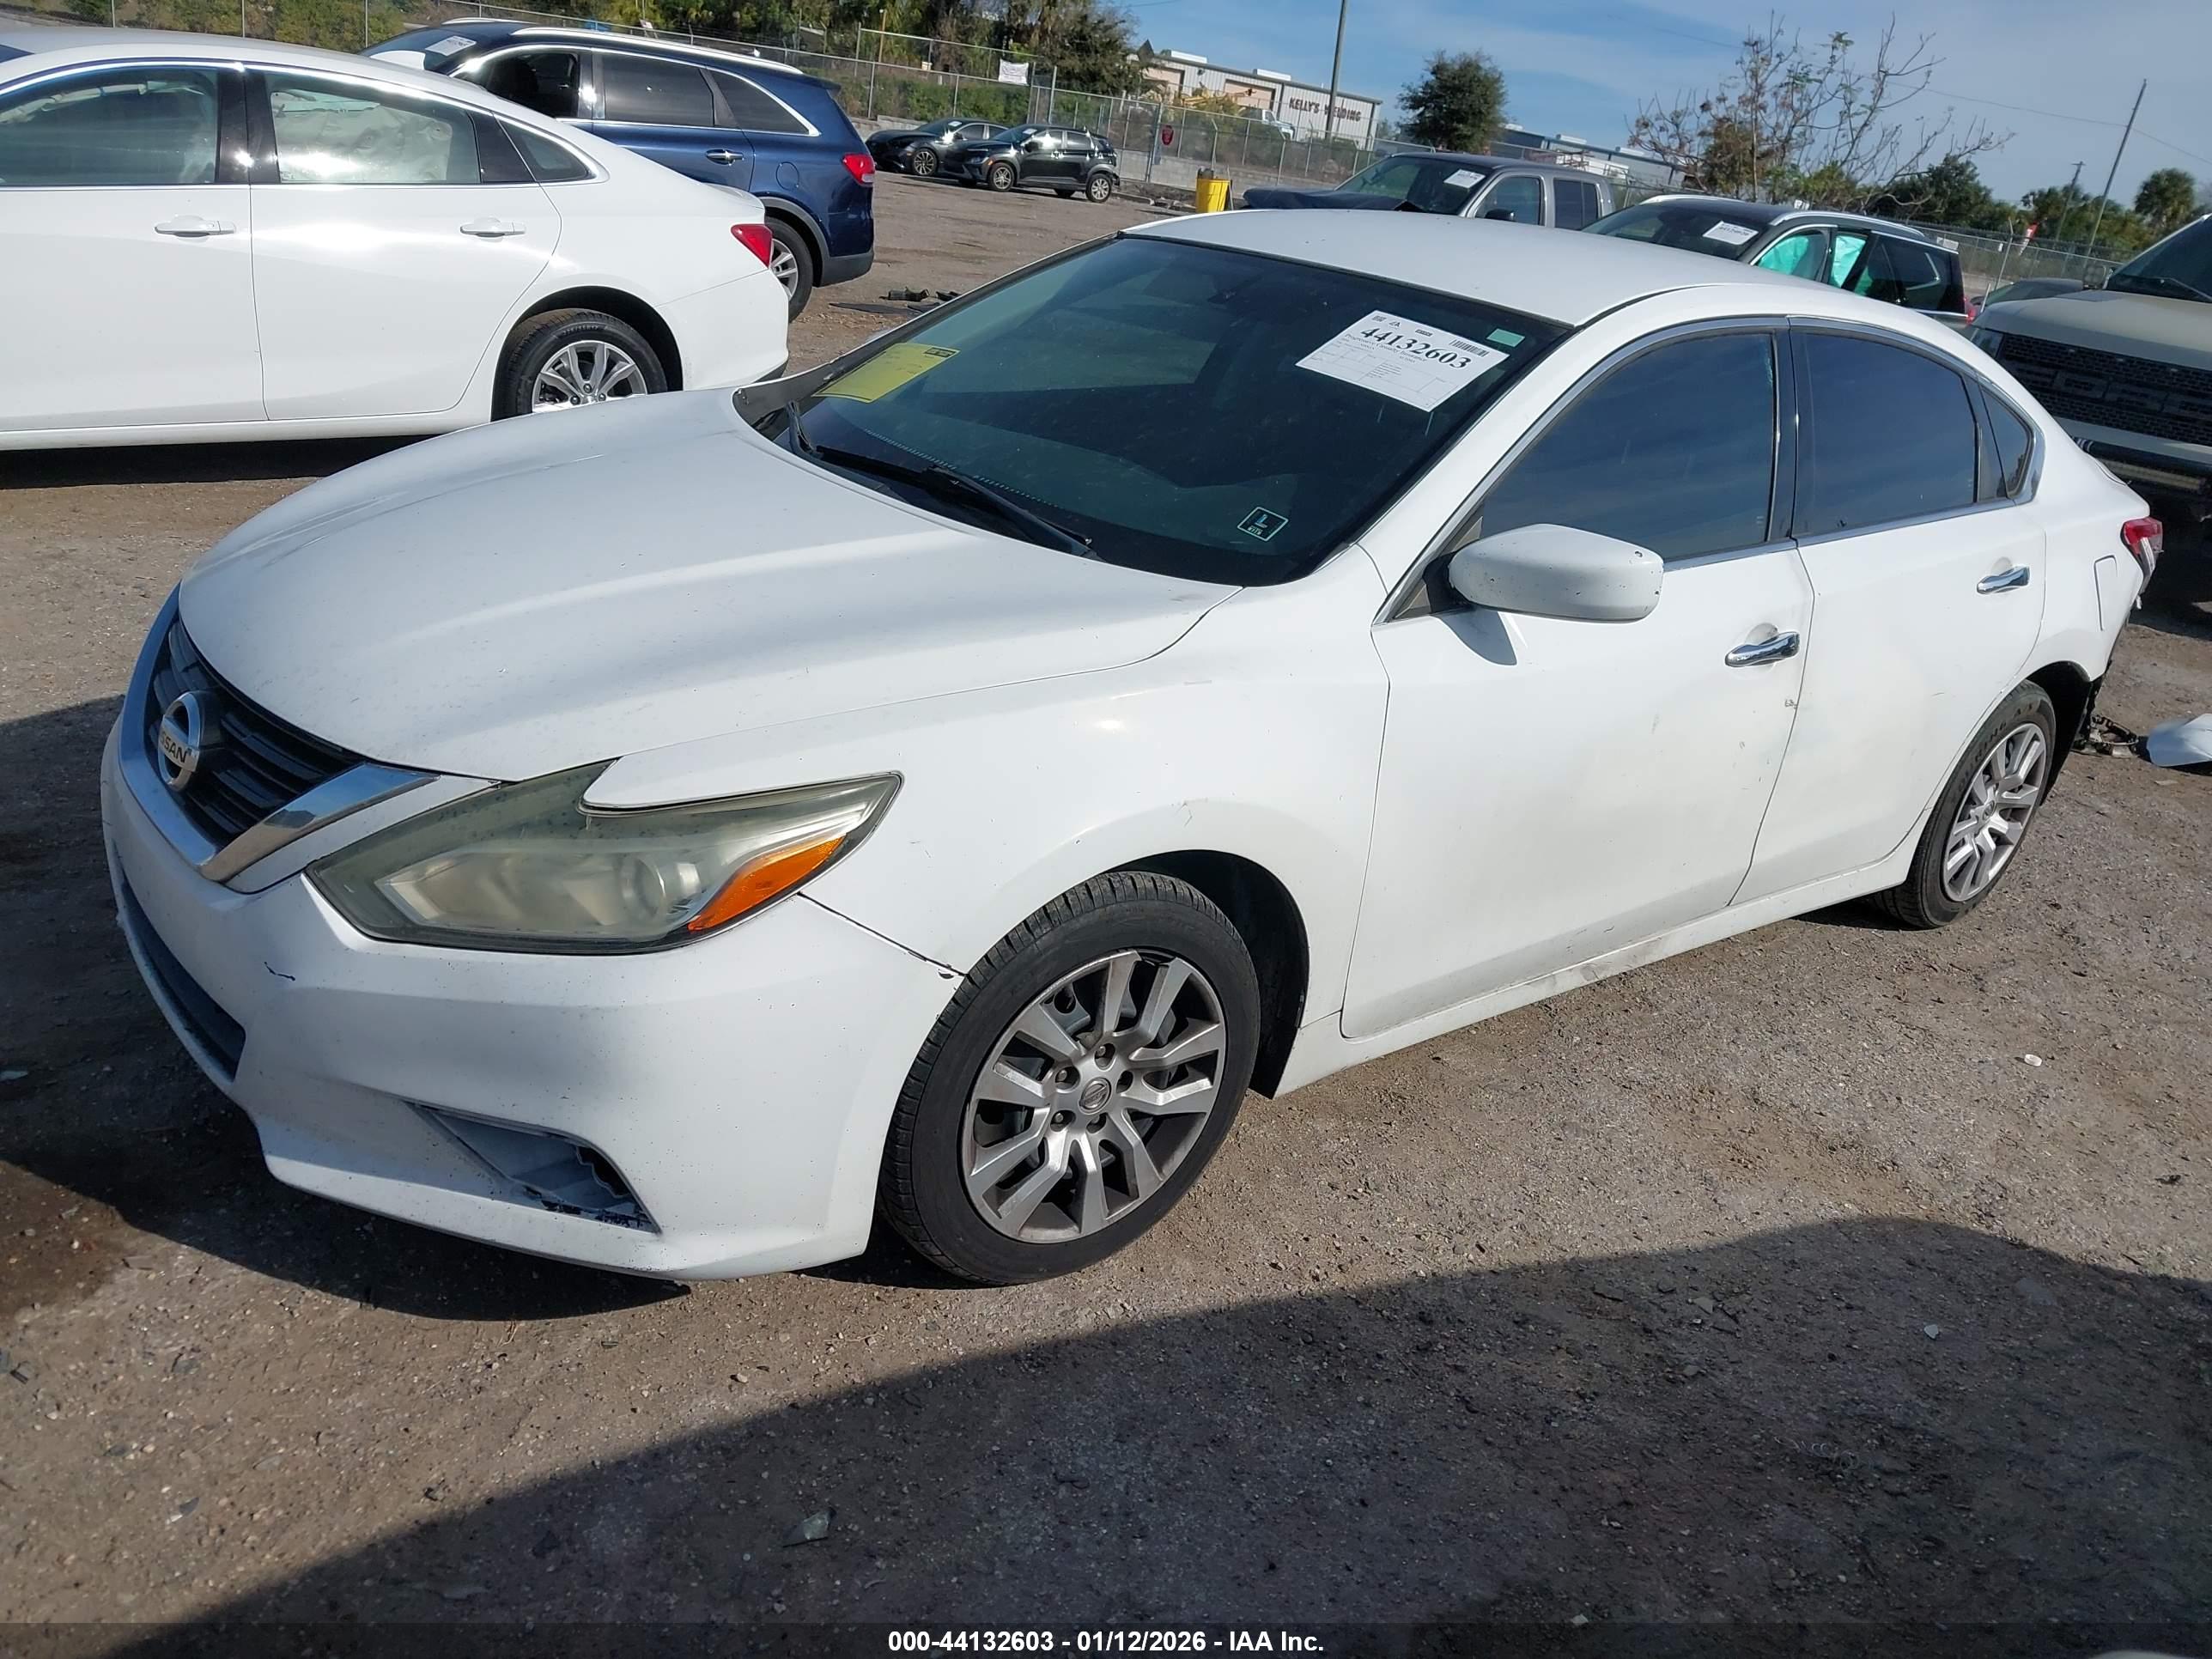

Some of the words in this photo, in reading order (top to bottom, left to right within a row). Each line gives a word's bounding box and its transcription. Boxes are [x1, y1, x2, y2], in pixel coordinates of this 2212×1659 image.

[1289, 97, 1320, 114] KELLY'S
[1360, 328, 1471, 369] 44132603
[160, 731, 188, 763] SSAN
